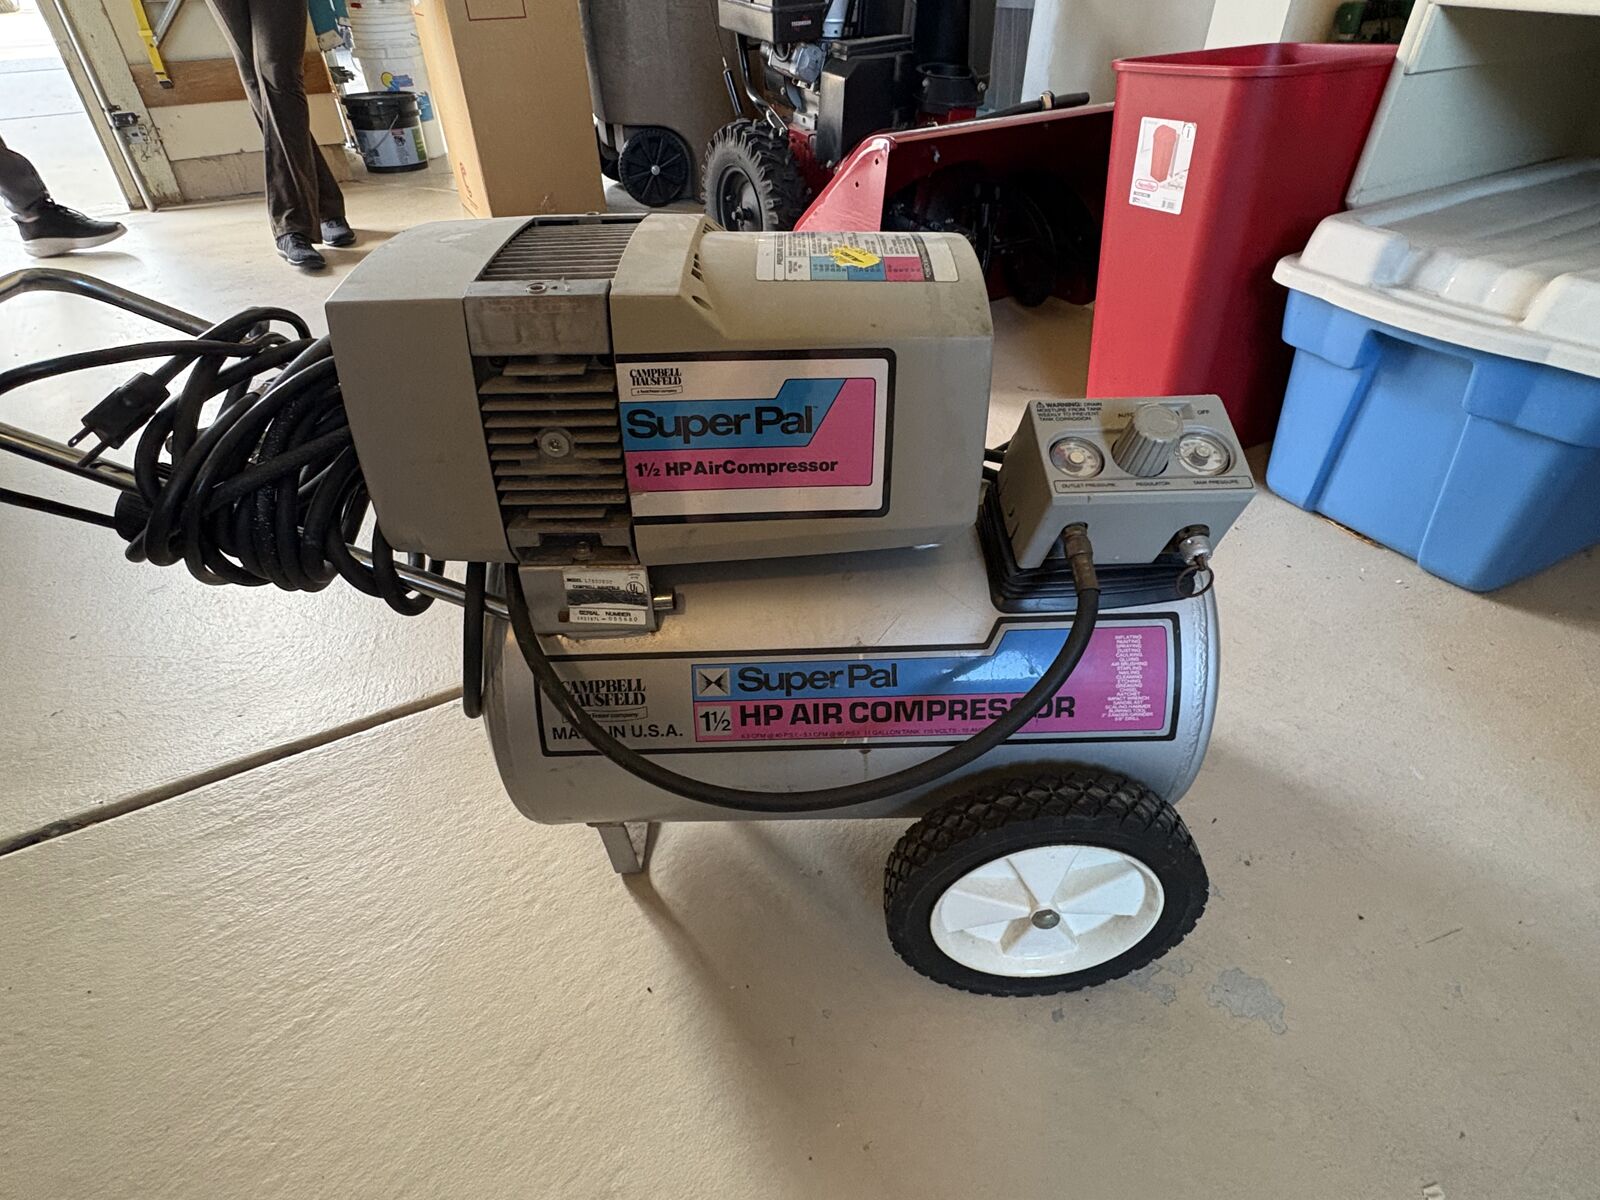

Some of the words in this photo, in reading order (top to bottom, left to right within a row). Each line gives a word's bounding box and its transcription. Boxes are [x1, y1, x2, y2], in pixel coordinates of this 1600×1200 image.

[629, 368, 682, 378] CAMPBELL
[632, 377, 682, 386] HAUSFELD
[626, 409, 751, 444] Super
[665, 461, 692, 476] HP
[737, 666, 844, 697] Super
[847, 663, 898, 689] Pal
[573, 692, 646, 707] AUSFELD
[739, 704, 784, 727] HP
[789, 702, 843, 725] AIR
[631, 724, 683, 738] U.S.A.
